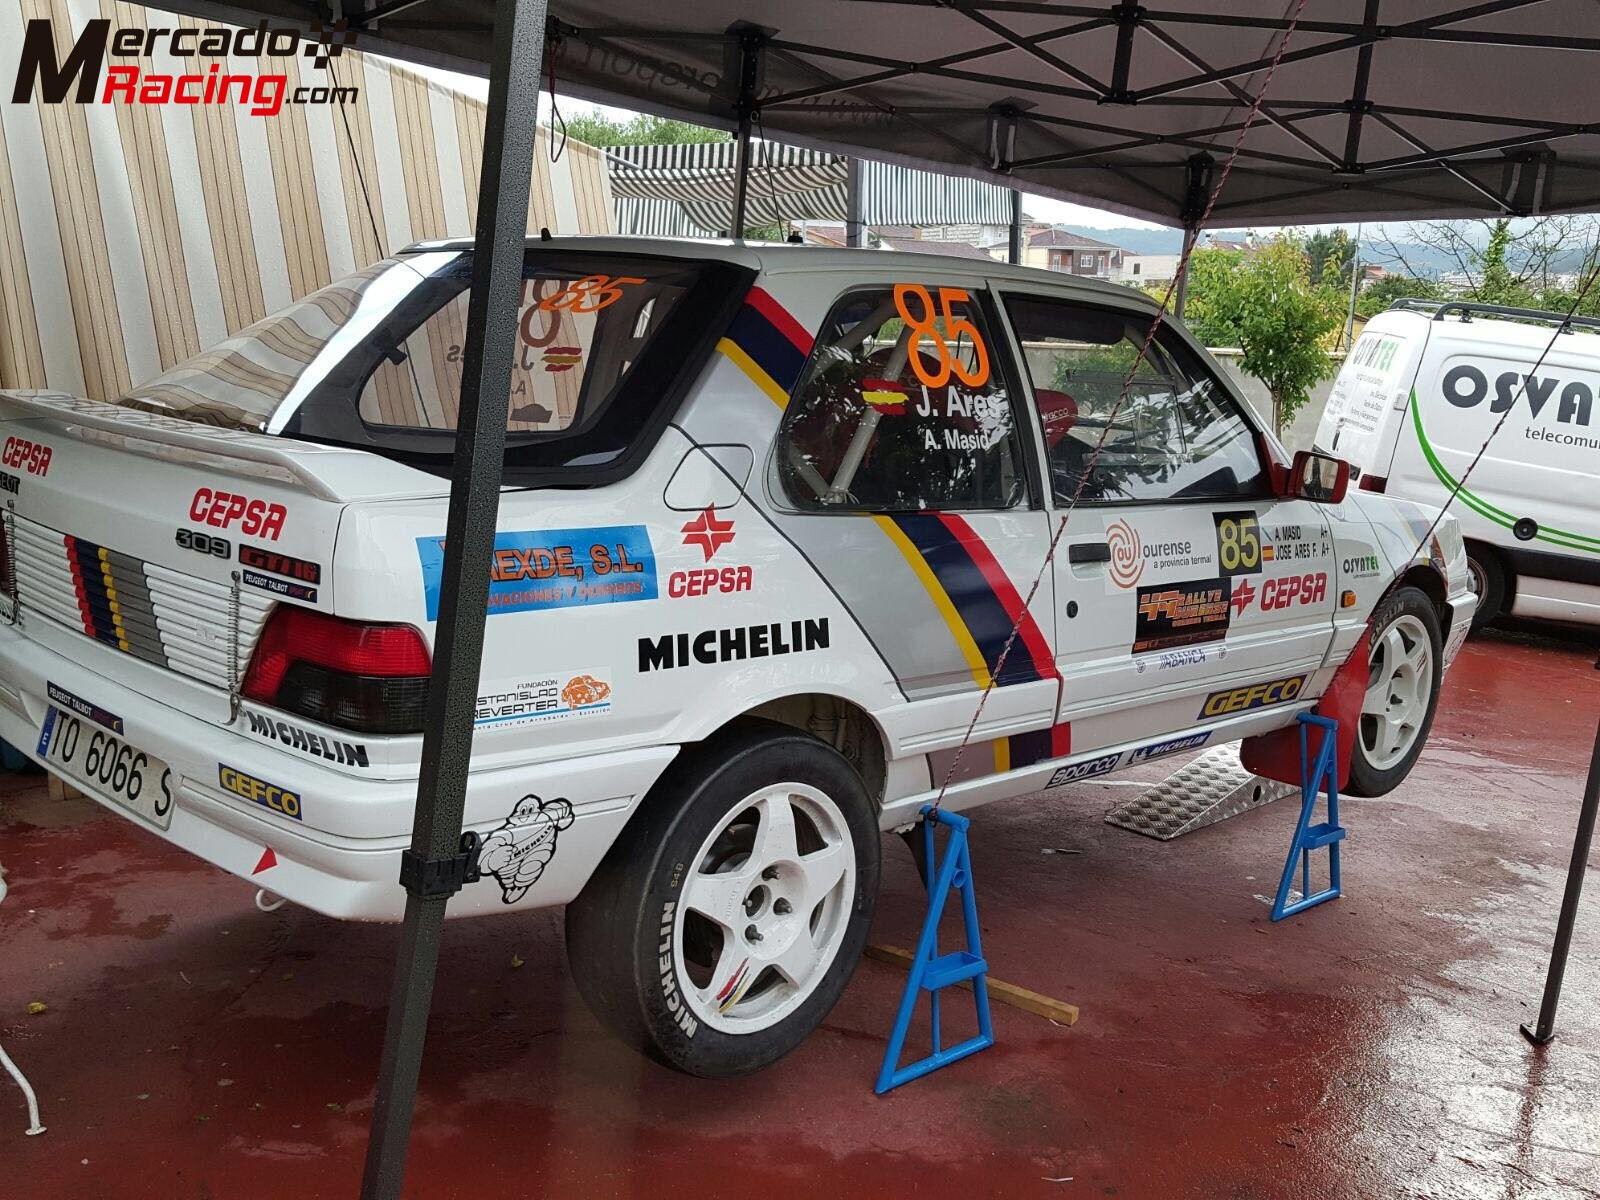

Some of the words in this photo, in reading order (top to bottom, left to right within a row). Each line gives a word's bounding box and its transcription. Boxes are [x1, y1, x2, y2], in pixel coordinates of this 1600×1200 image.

[538, 274, 648, 313] 85
[893, 283, 990, 388] 85
[916, 385, 938, 417] J.
[947, 385, 1000, 417] Ares
[1442, 365, 1600, 427] OSVA
[925, 429, 941, 449] A.
[2, 436, 53, 477] CEPSA
[189, 487, 288, 541] CEPSA
[175, 528, 231, 559] 309
[590, 544, 644, 575] S.L.
[1143, 541, 1192, 558] ourense
[1219, 518, 1260, 570] 85
[1275, 544, 1292, 560] JOSE
[1294, 543, 1310, 558] ARES
[1160, 557, 1190, 570] provincia
[1191, 554, 1212, 566] termal
[245, 574, 267, 587] PEUGEOT
[268, 577, 288, 592] TALBOT
[667, 566, 753, 598] CEPSA
[1260, 572, 1327, 611] CEPSA
[638, 617, 830, 672] MICHELIN
[49, 687, 71, 705] PEUGEOT
[72, 699, 92, 716] TALBOT
[476, 688, 558, 706] STANISLAO
[1205, 676, 1302, 716] GEFCO
[42, 732, 48, 745] E
[246, 711, 369, 767] MICHELIN
[1151, 734, 1209, 756] MICHELIN
[52, 709, 80, 762] TO
[86, 731, 147, 800] 6066
[155, 767, 171, 816] S
[1051, 755, 1118, 783] sparco
[221, 767, 299, 816] GEFCO
[513, 824, 552, 858] MICHELIN
[659, 902, 698, 1039] MICHELIN
